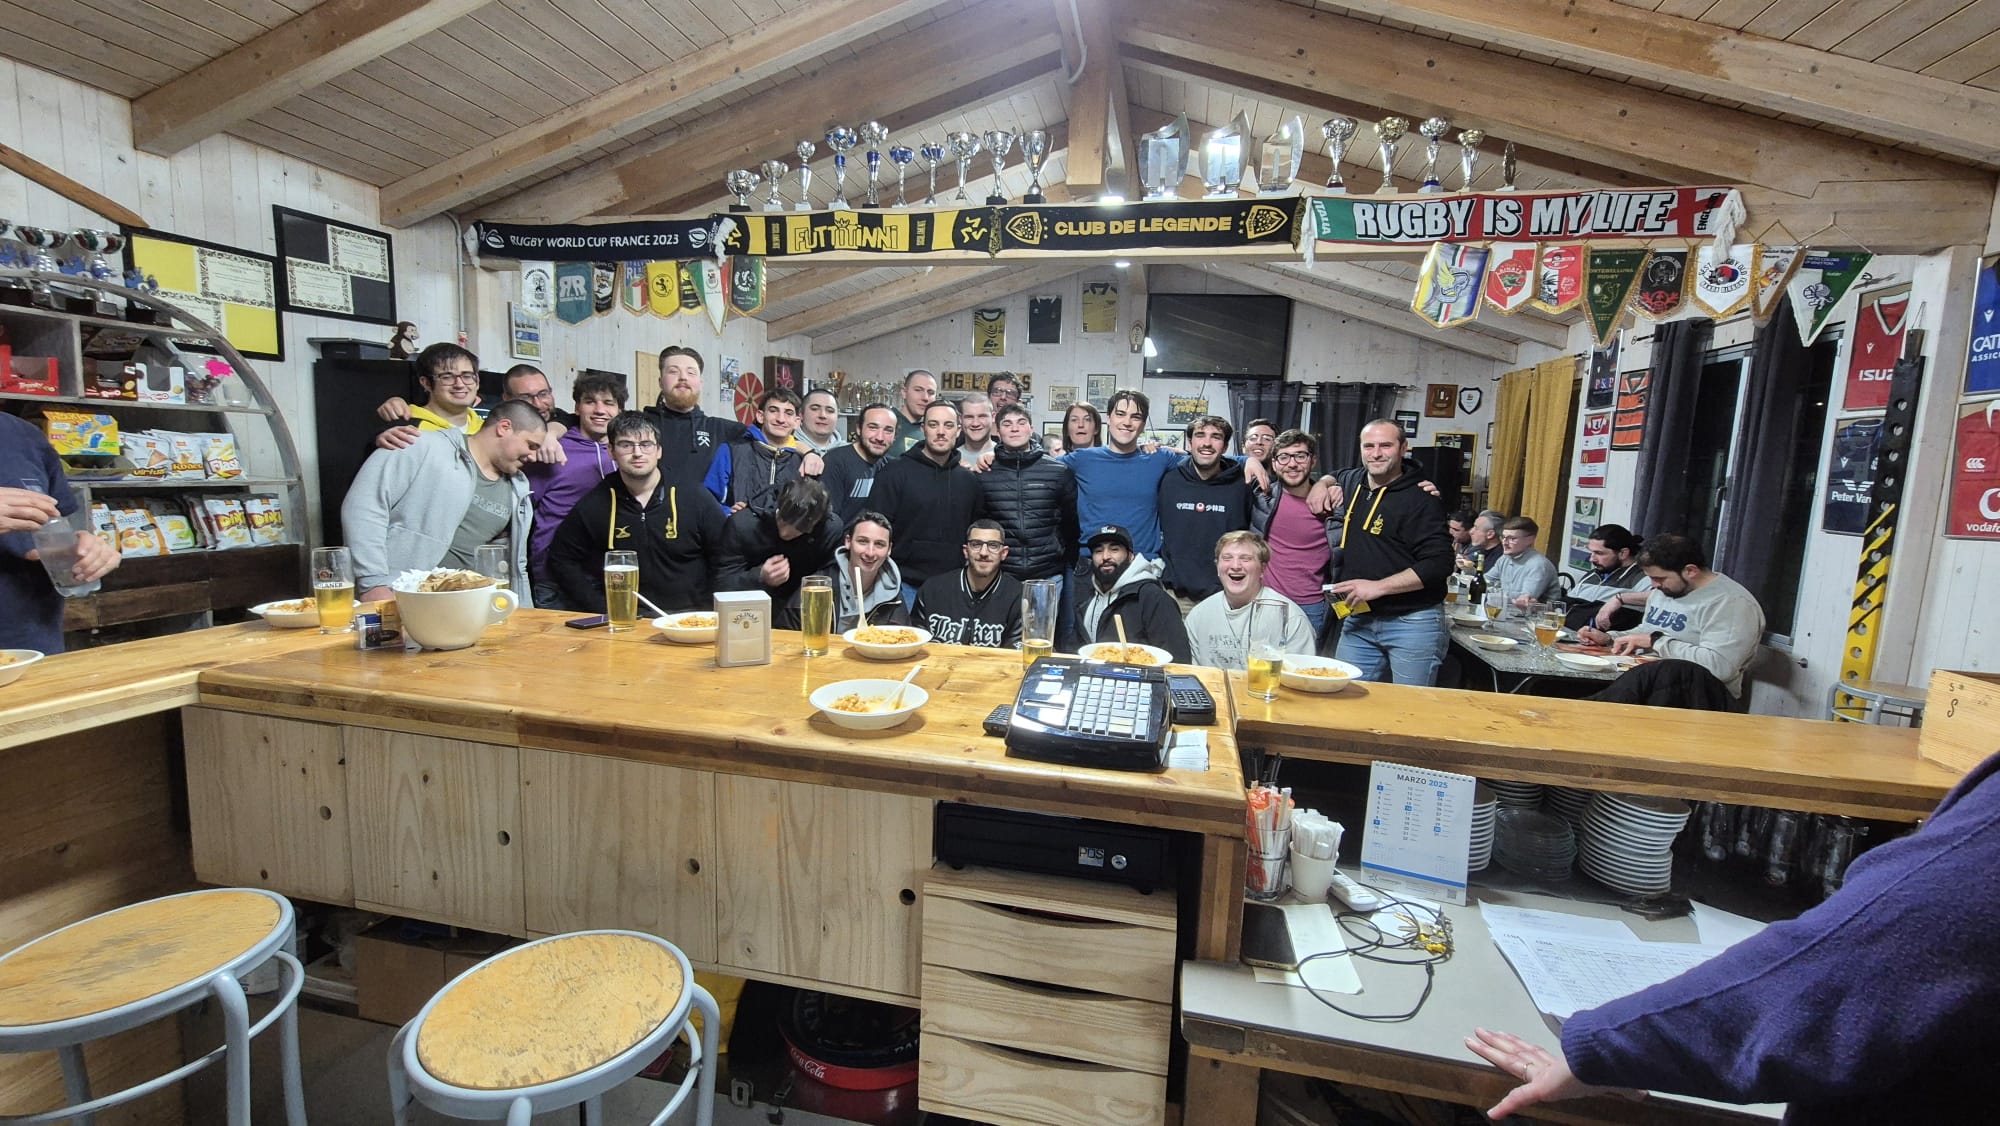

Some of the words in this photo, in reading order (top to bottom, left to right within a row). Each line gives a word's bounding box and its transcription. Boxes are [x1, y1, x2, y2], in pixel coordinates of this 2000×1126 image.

[1313, 200, 1331, 235] ITALIA
[1353, 198, 1476, 238] RUGBY
[1482, 199, 1522, 238] IS
[1529, 194, 1593, 236] MY
[1591, 192, 1675, 234] LIFE
[1055, 219, 1106, 236] CLUB
[1109, 219, 1136, 235] DE
[1139, 216, 1233, 233] LEGENDE
[510, 235, 544, 247] RUGBY
[547, 236, 586, 248] WORLD
[587, 236, 607, 248] CUP
[609, 234, 651, 247] FRANCE
[652, 234, 679, 246] 2023
[1859, 368, 1894, 381] ISUZ
[1831, 490, 1855, 502] Peter
[1397, 773, 1427, 785] MARZO
[1428, 779, 1448, 789] 2025
[1079, 848, 1104, 859] POS
